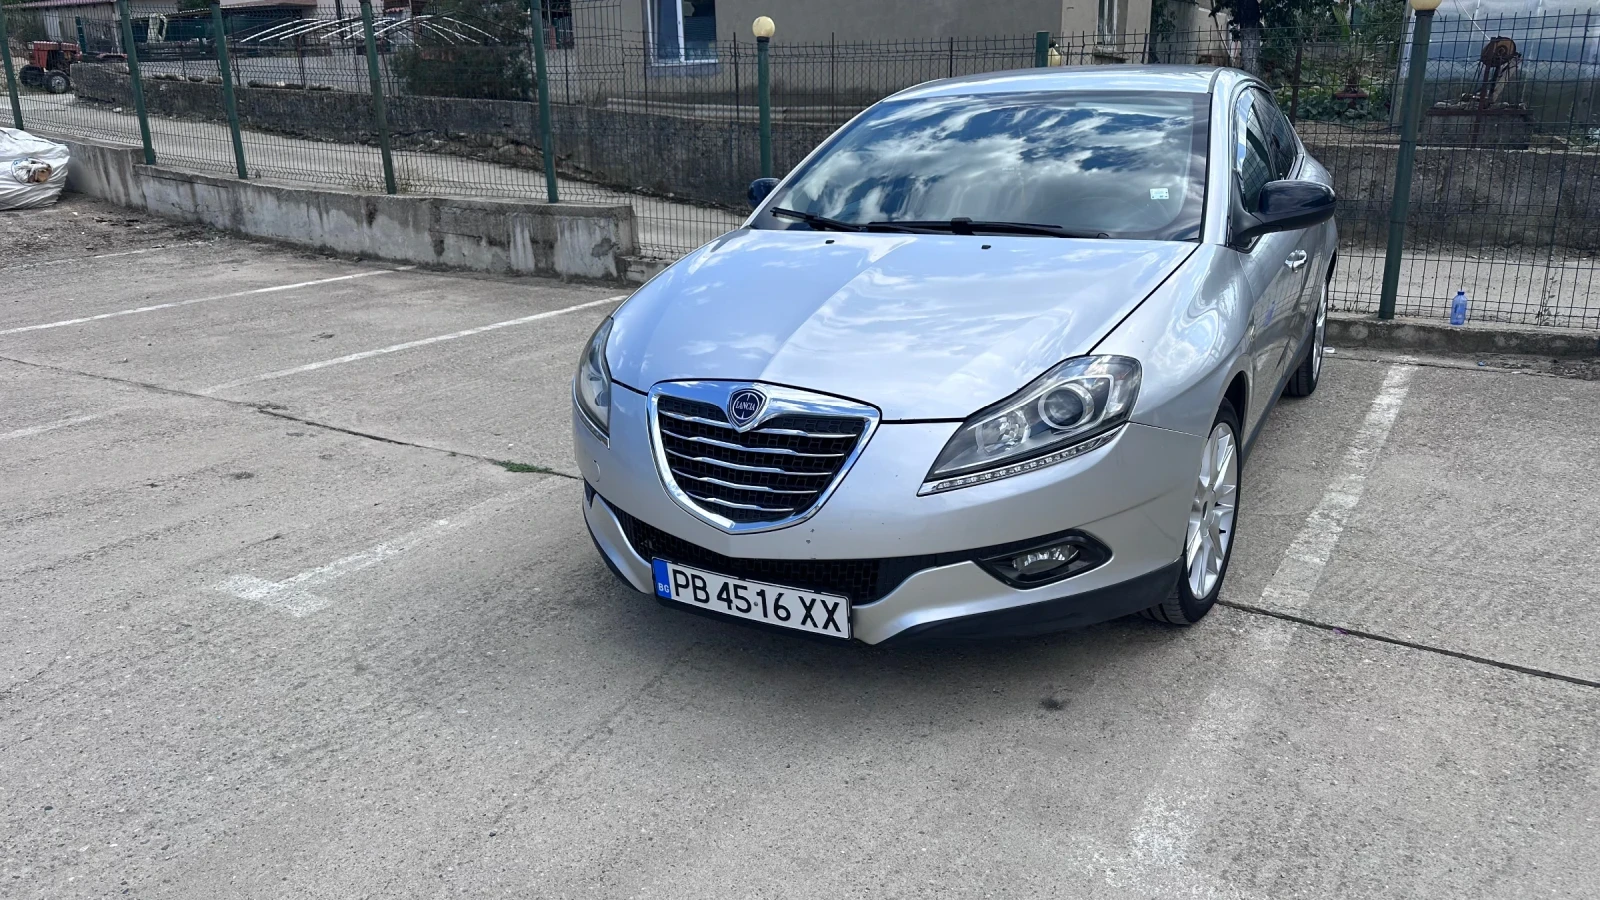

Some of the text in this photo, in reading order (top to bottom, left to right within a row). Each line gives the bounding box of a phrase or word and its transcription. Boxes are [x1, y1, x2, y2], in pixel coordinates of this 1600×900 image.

[735, 401, 756, 412] LANCIA
[658, 582, 670, 593] BG
[672, 568, 710, 604] PB
[798, 595, 842, 633] XX
